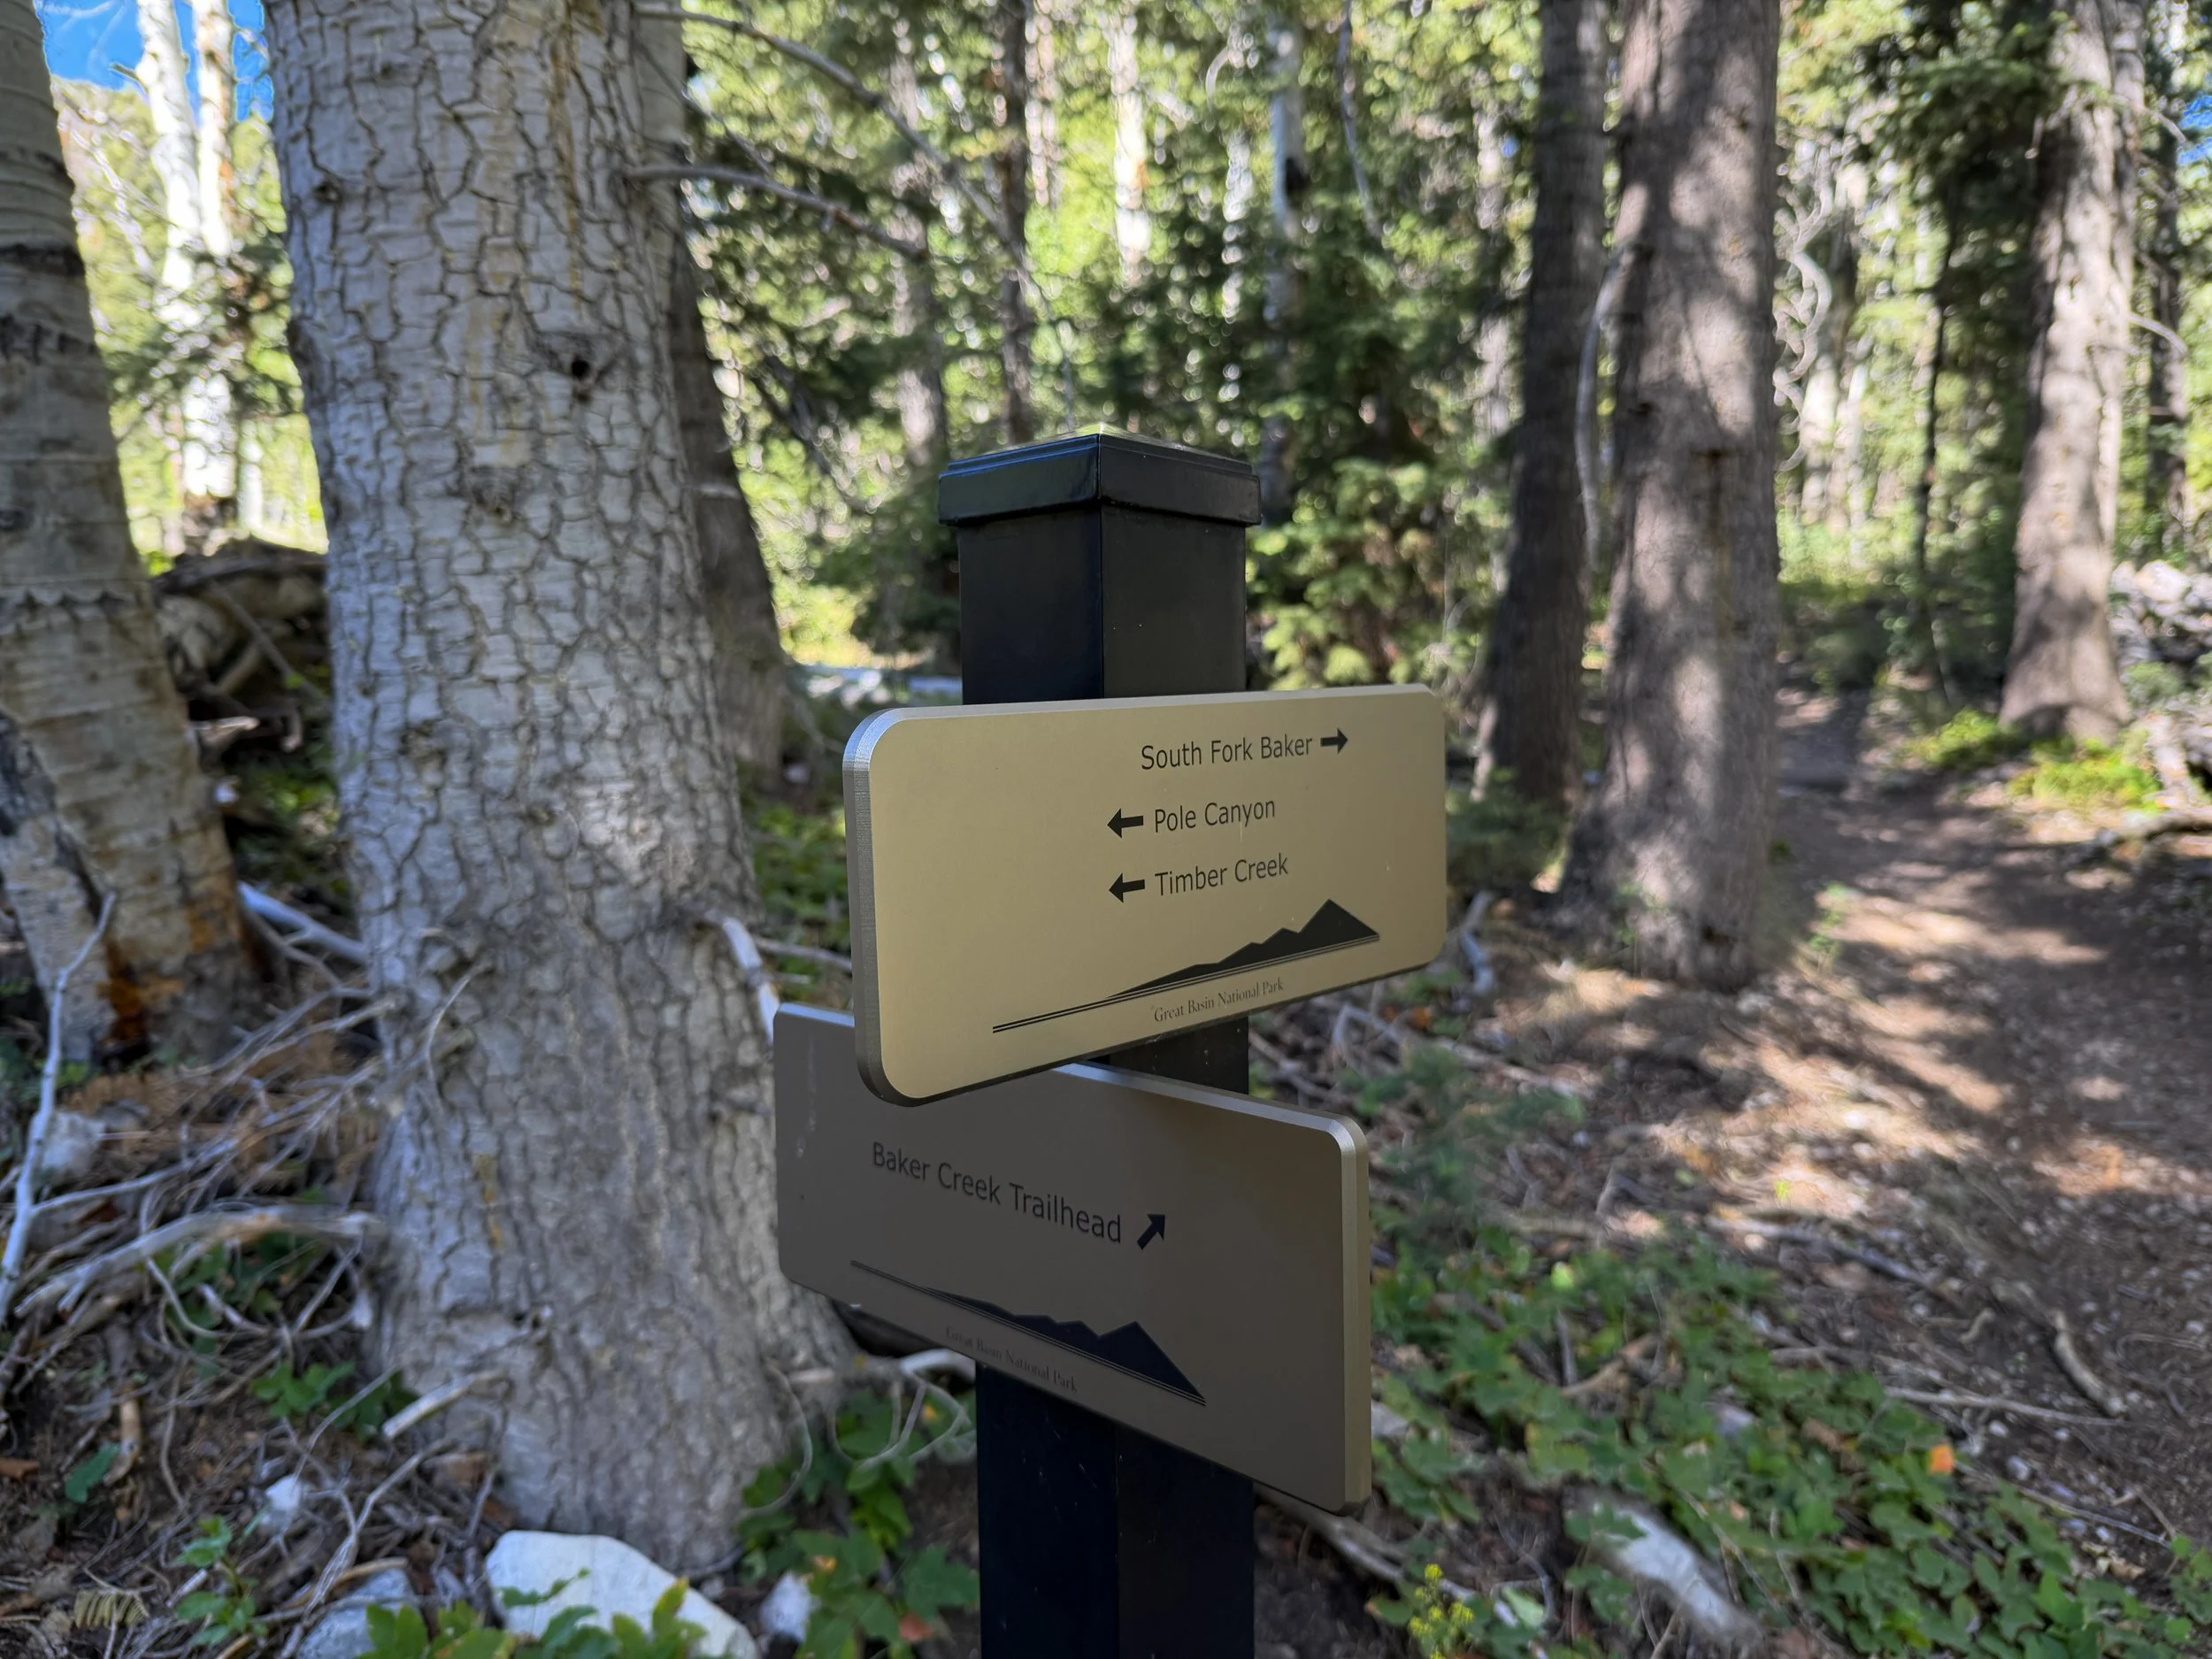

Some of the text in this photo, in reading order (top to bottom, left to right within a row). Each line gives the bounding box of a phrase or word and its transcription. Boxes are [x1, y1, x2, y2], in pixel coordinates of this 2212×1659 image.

[1141, 733, 1313, 770] South Fork Baker
[1155, 800, 1275, 833] Pole Canyon
[1155, 852, 1288, 896] Timber Creek
[1154, 977, 1284, 1022] Great Basin National Park
[872, 1141, 1121, 1243] Baker Creek Trailhead
[946, 1325, 1078, 1393] Great Basin National Park
